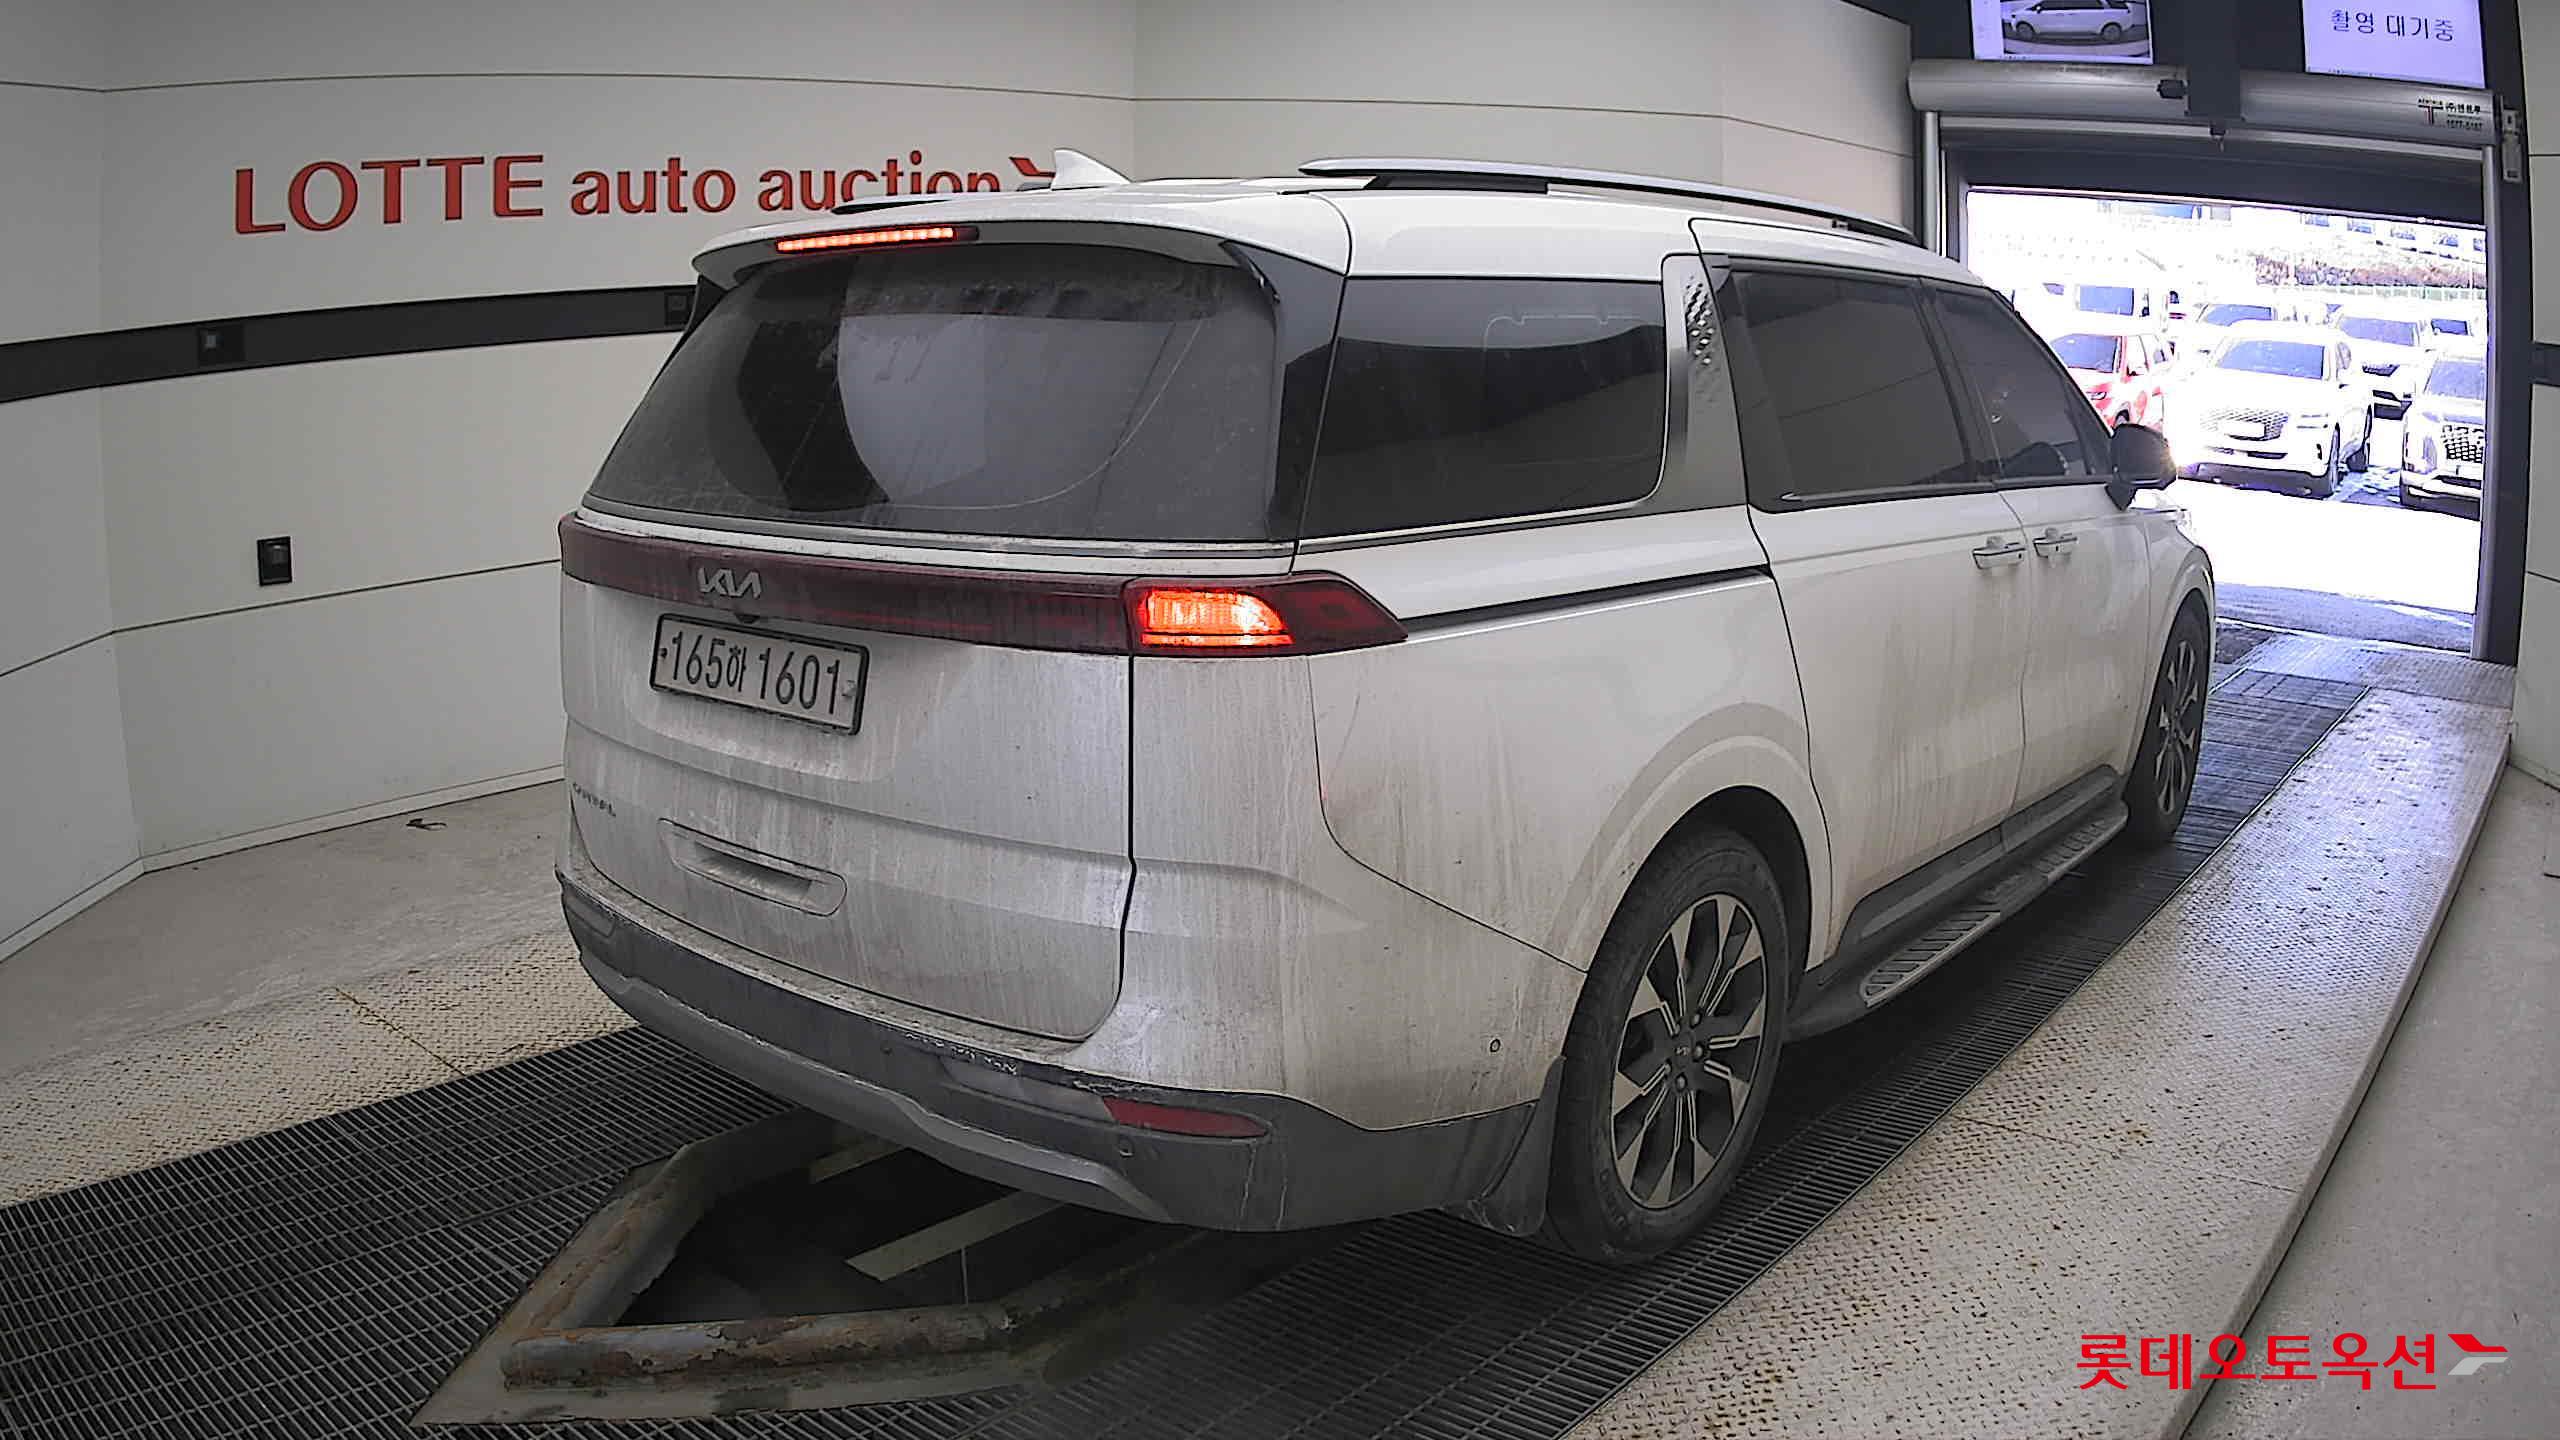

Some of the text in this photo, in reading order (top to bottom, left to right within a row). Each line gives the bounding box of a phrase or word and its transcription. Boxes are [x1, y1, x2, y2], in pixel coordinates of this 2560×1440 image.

[2330, 9, 2453, 42] 촬영 대기중
[235, 149, 1001, 236] LOTTE auto auction
[698, 567, 763, 598] KIA
[671, 630, 840, 715] 165하 1601
